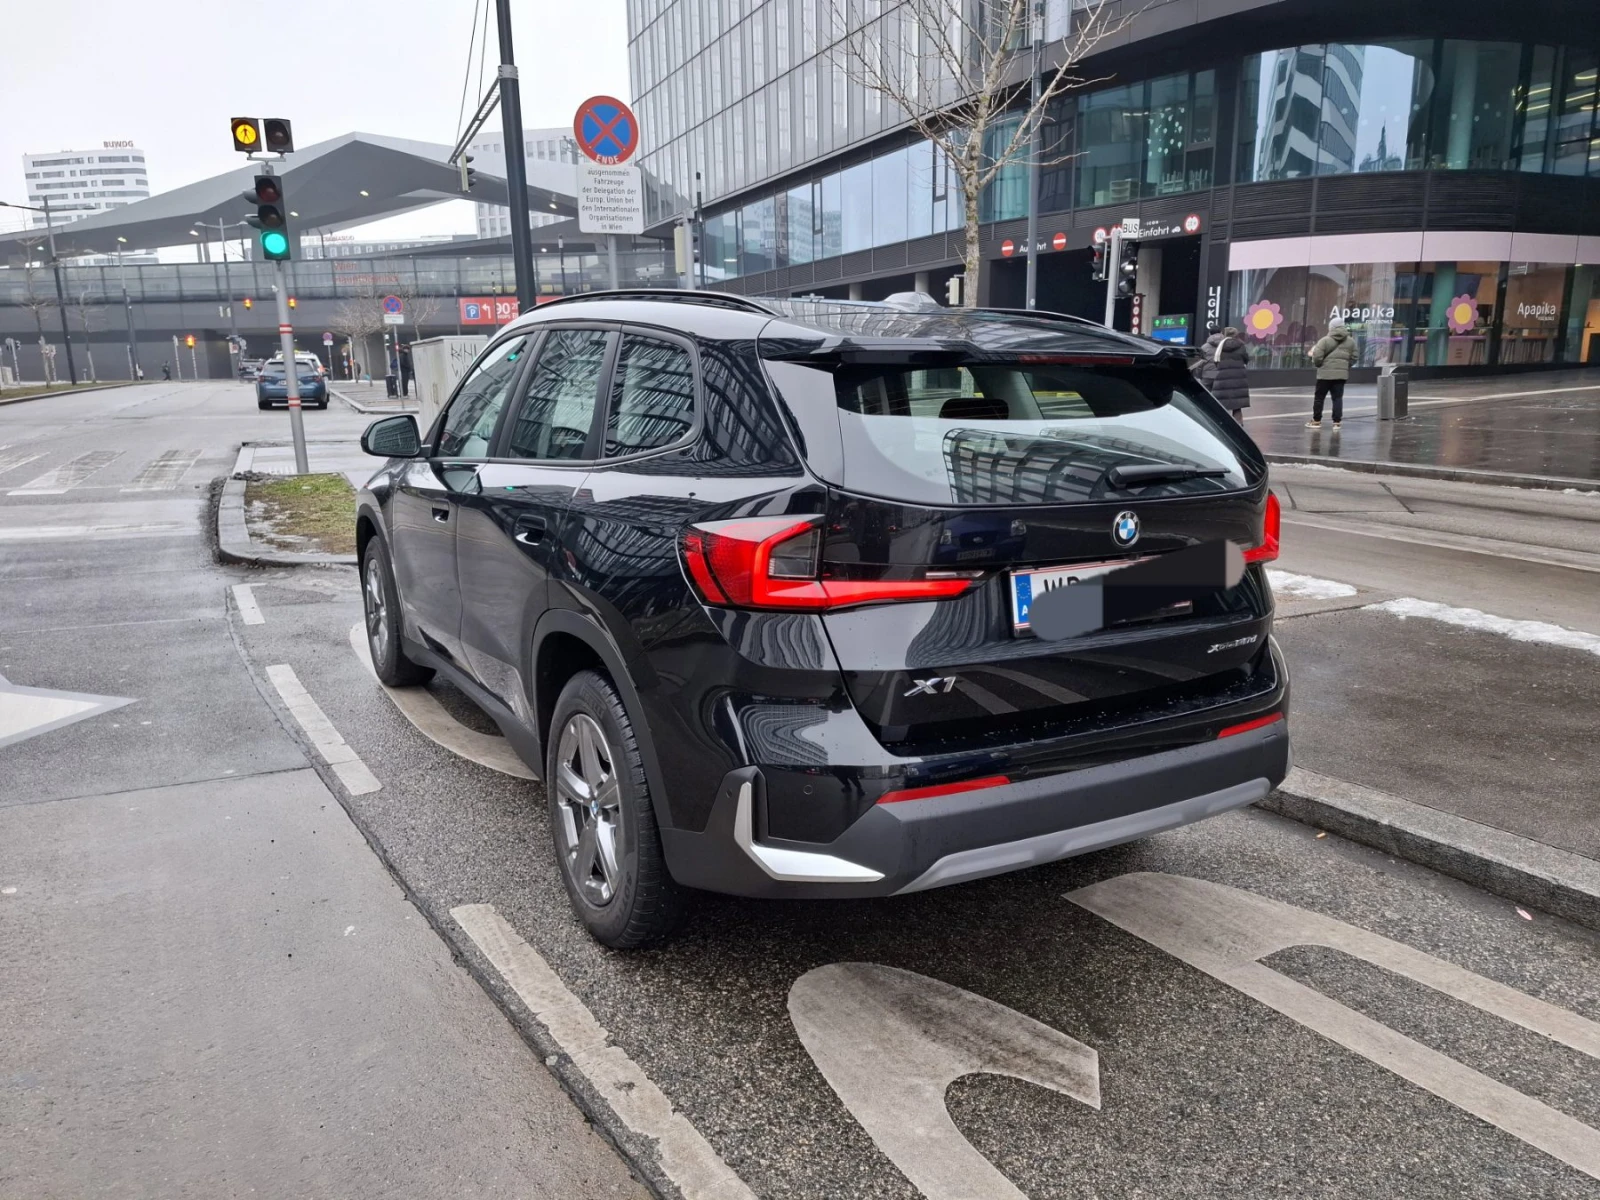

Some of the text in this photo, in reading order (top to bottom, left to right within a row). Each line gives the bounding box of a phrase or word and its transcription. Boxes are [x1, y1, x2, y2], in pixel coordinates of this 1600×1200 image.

[595, 154, 621, 164] ENDE
[587, 168, 630, 177] ausgenommen
[593, 177, 625, 187] Fahrzeuge
[594, 187, 626, 196] Delegation
[586, 196, 604, 205] Europ.
[606, 196, 624, 204] Union
[594, 205, 640, 213] Internationalen
[588, 213, 634, 222] Organisationen
[1123, 223, 1139, 233] BUS
[1139, 226, 1169, 238] Einfahrt
[1329, 304, 1395, 322] Apapika
[1517, 301, 1556, 318] Apapika
[903, 676, 957, 697] X1
